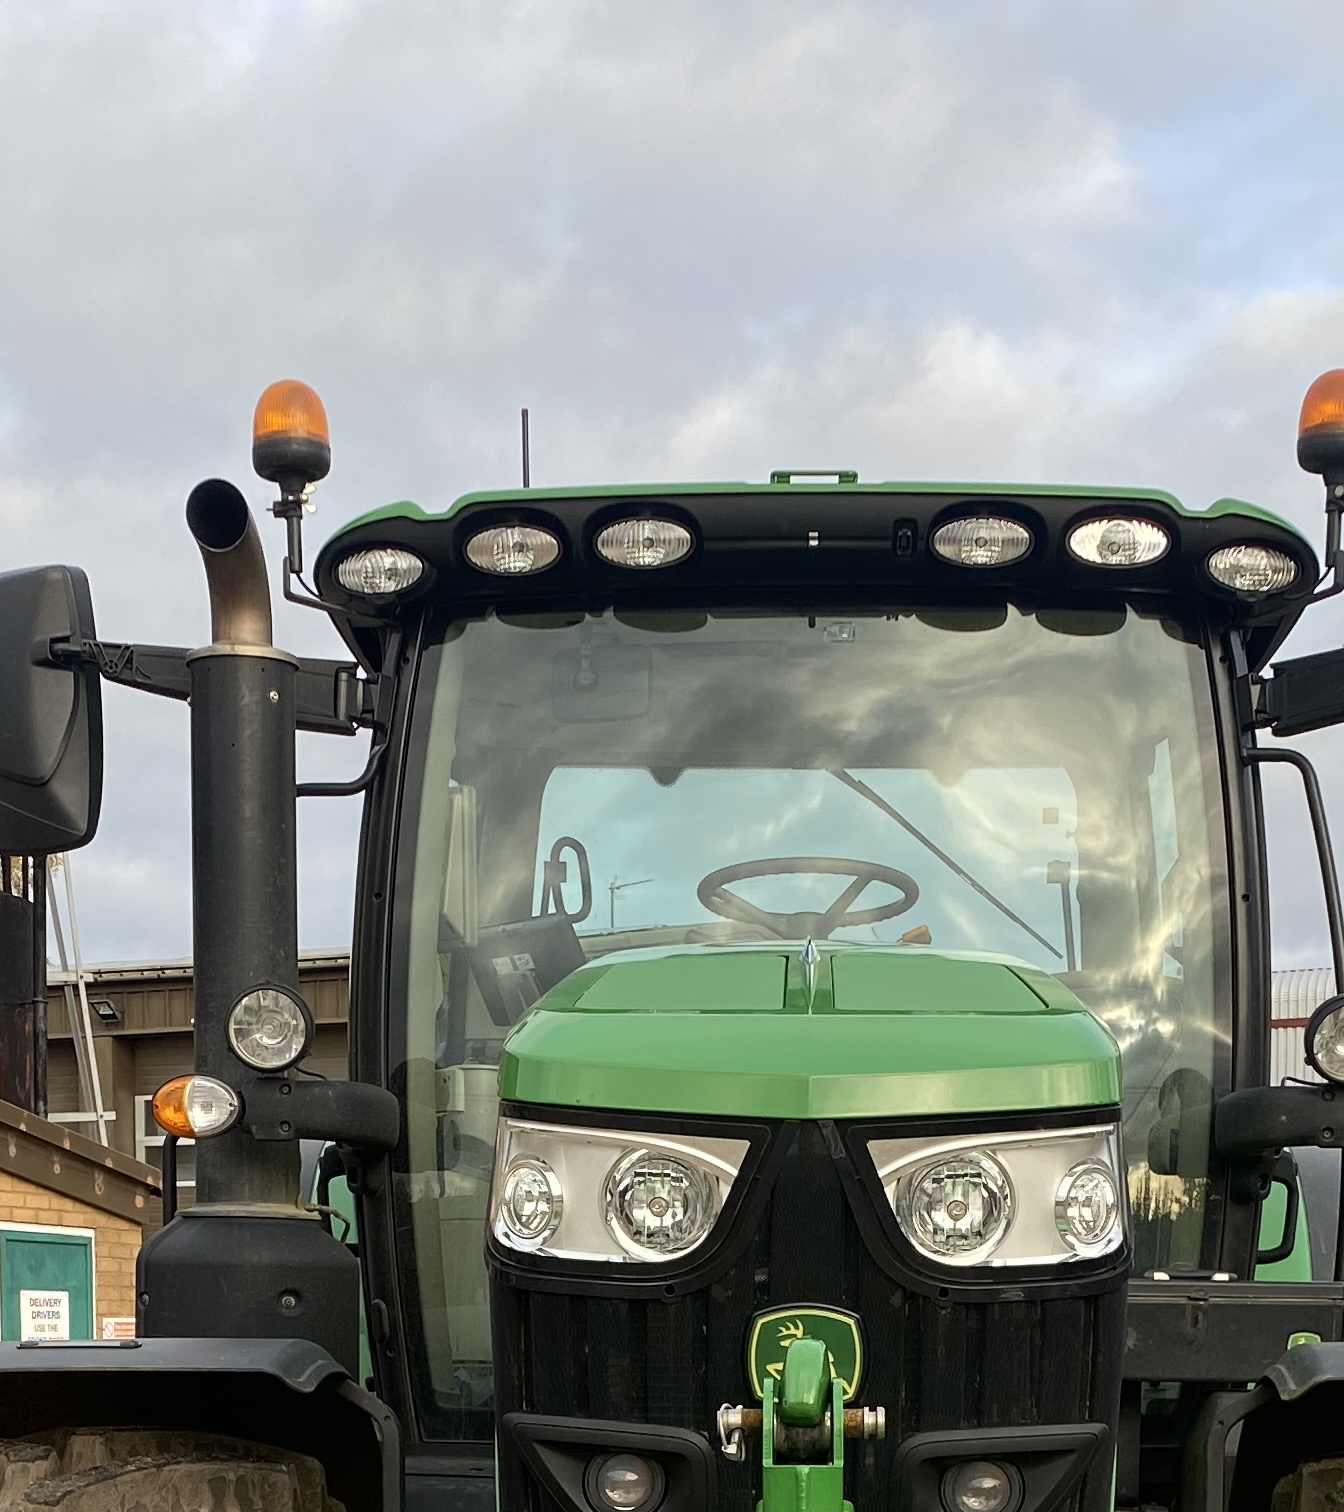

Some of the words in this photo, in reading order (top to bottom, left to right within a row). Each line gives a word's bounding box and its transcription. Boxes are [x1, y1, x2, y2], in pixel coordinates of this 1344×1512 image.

[29, 1298, 62, 1307] DELIVERY
[31, 1311, 60, 1320] DRIVERS
[34, 1324, 46, 1333] USE
[47, 1324, 58, 1333] THE
